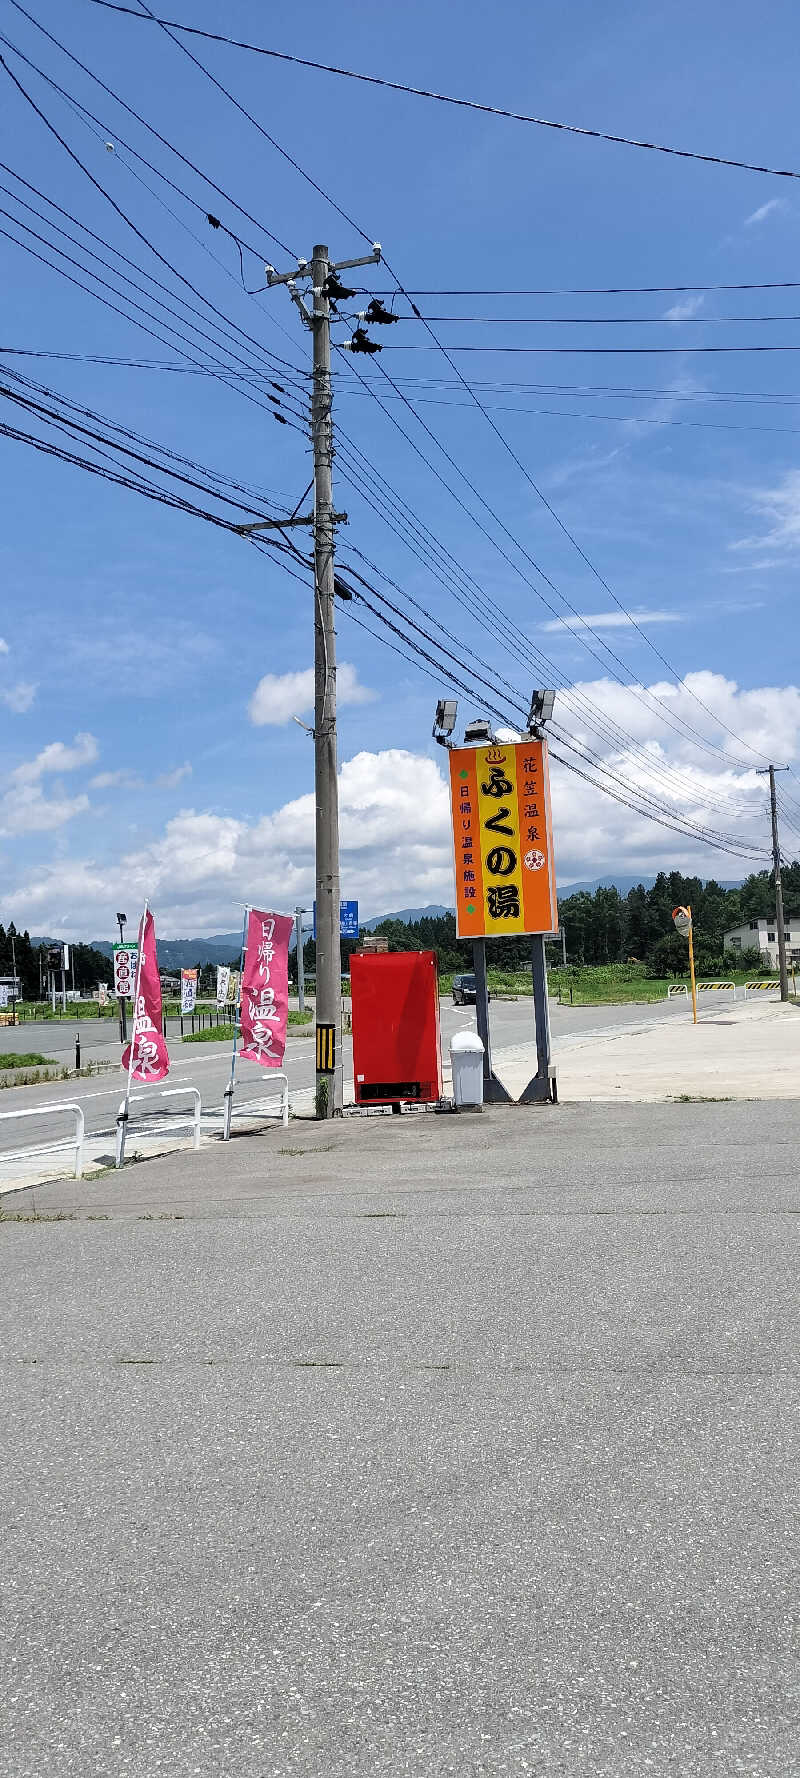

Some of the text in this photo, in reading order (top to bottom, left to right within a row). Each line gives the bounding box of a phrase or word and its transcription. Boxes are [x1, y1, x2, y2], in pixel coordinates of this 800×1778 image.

[459, 786, 476, 898] 日帰り温泉施設
[481, 767, 520, 920] ふくの湯
[523, 757, 541, 842] 花笠温泉
[246, 918, 281, 1060] 日帰り温泉
